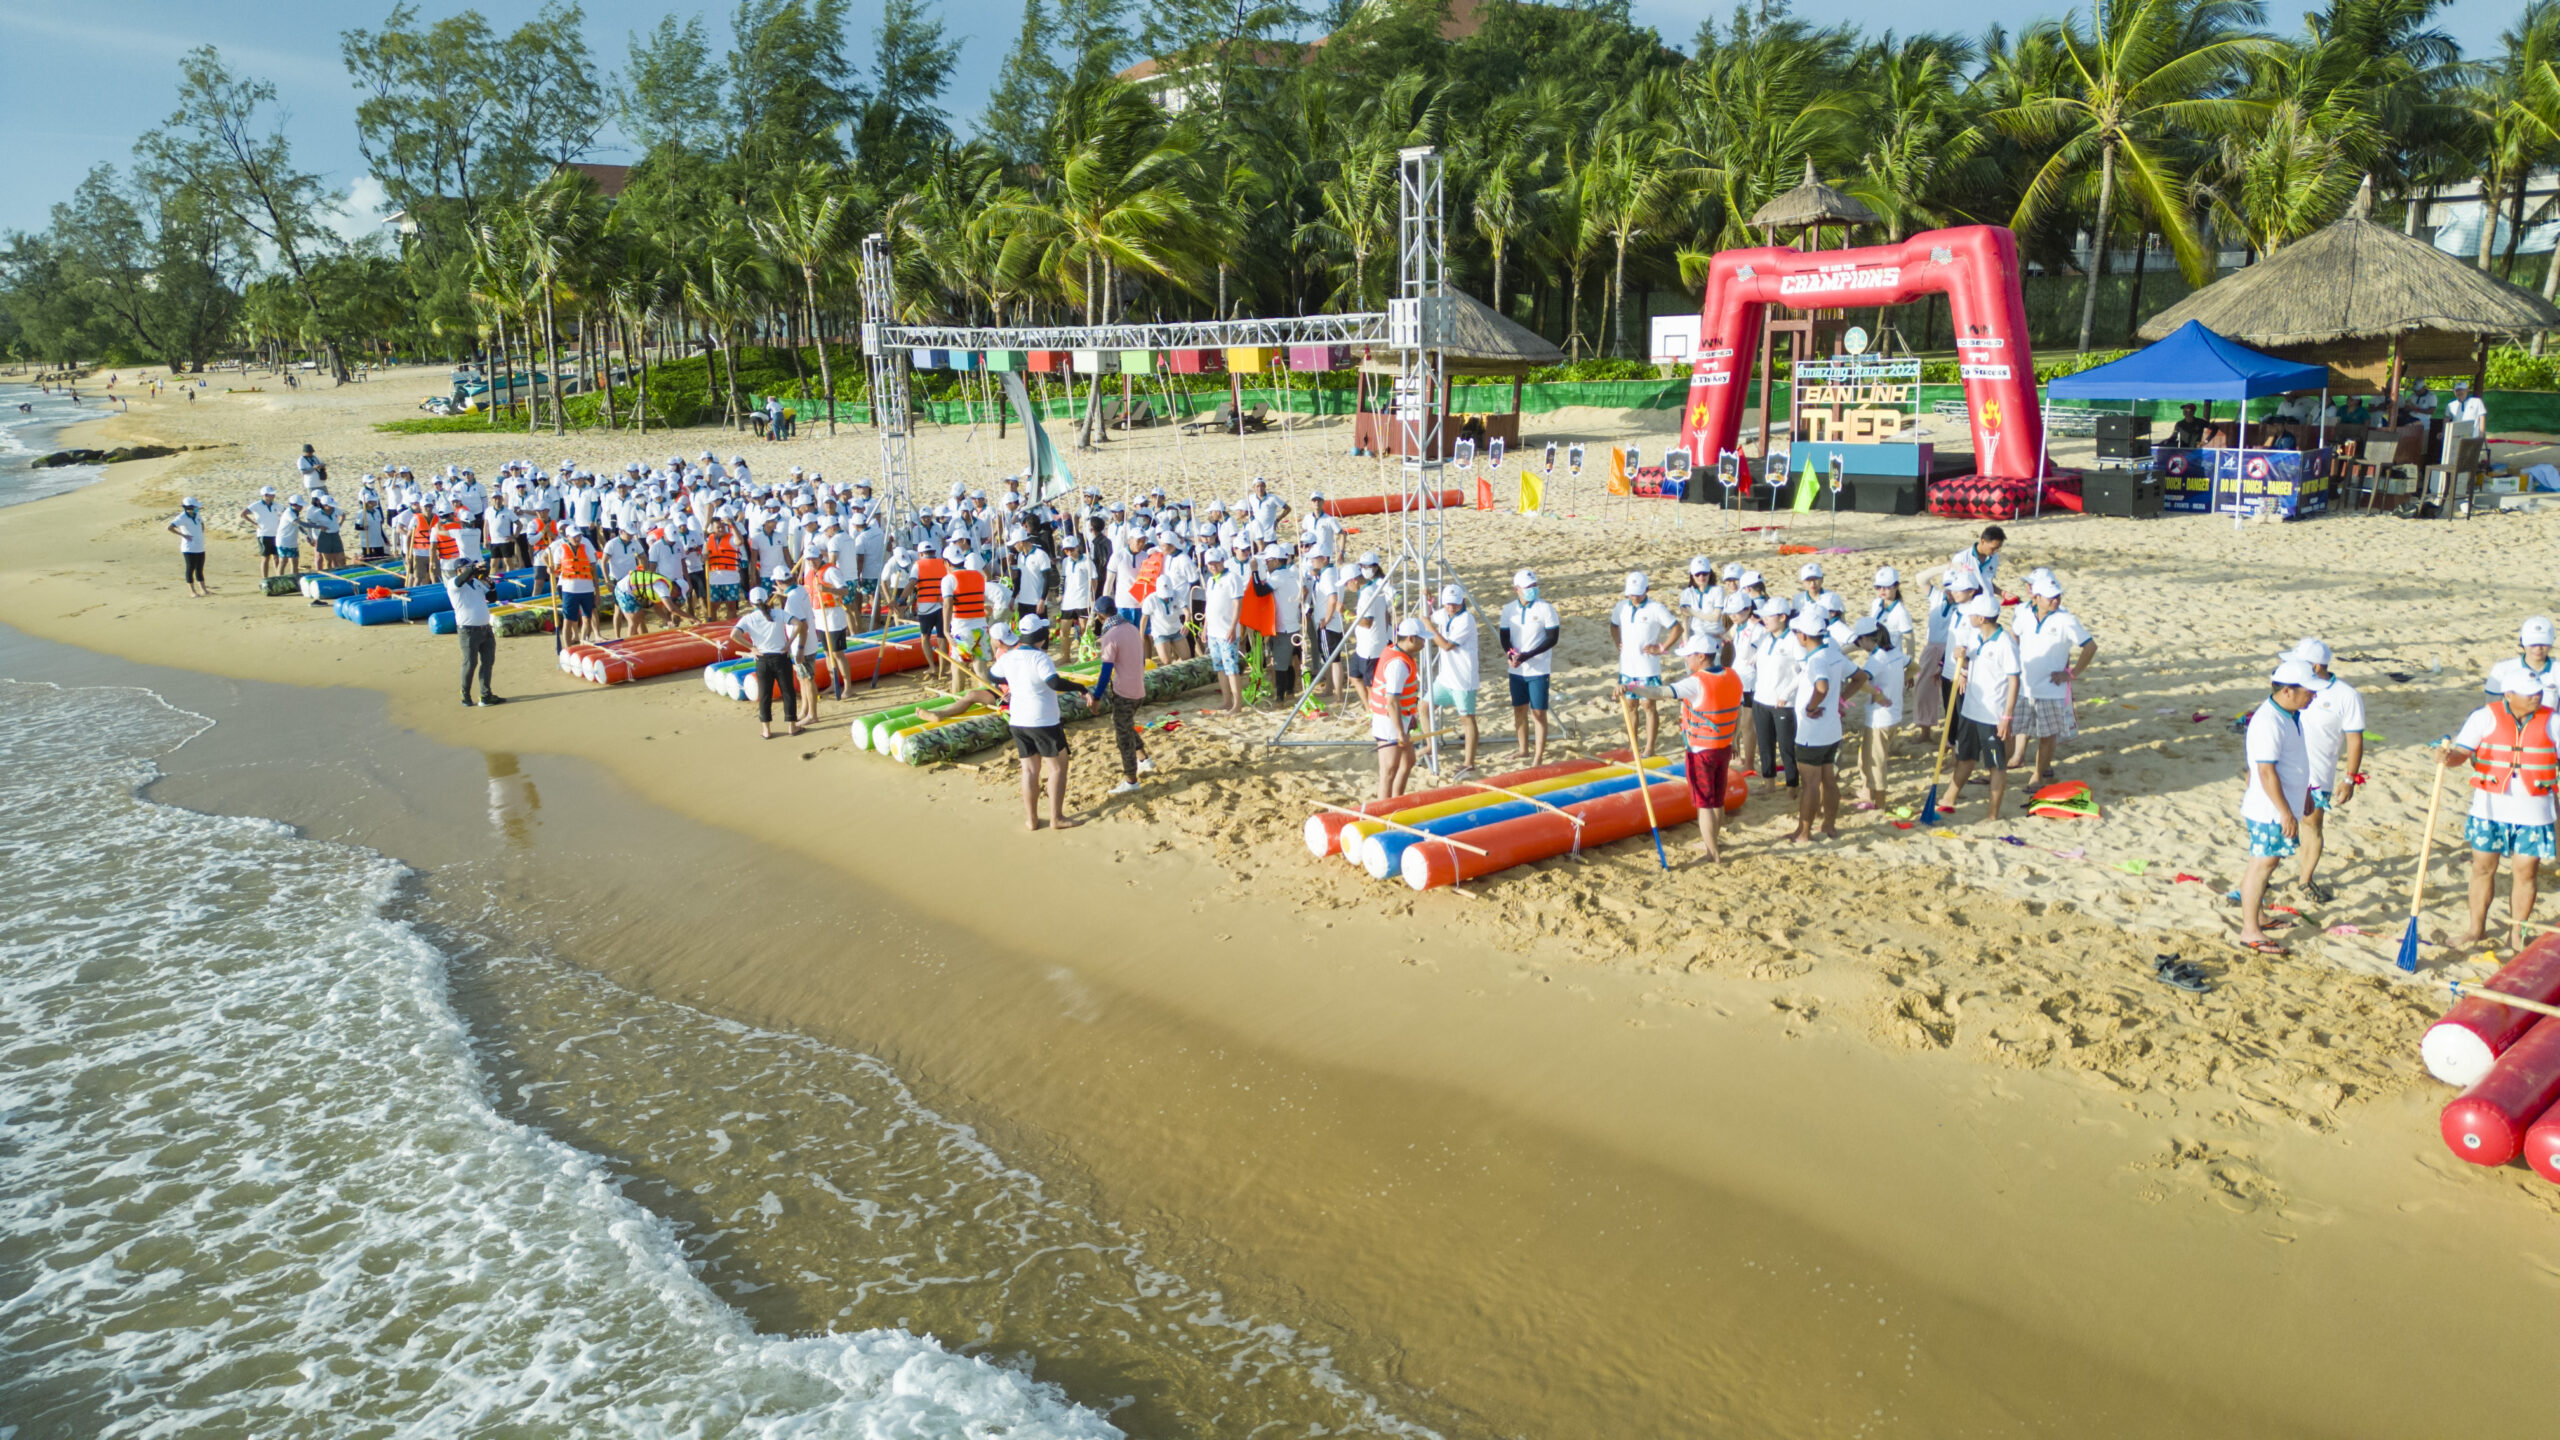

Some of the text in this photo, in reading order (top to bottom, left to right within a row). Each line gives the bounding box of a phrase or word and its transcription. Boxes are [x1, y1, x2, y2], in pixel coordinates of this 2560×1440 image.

[1780, 267, 1901, 295] CHAMPIONS
[1701, 337, 1723, 348] WIN
[1797, 362, 1919, 383] Amazing Race 2023
[1804, 381, 1852, 403] BẢN
[1801, 404, 1901, 444] THÉP
[2186, 477, 2210, 491] DANGER
[2243, 480, 2263, 494] TOUCH
[2267, 481, 2293, 496] DANGER
